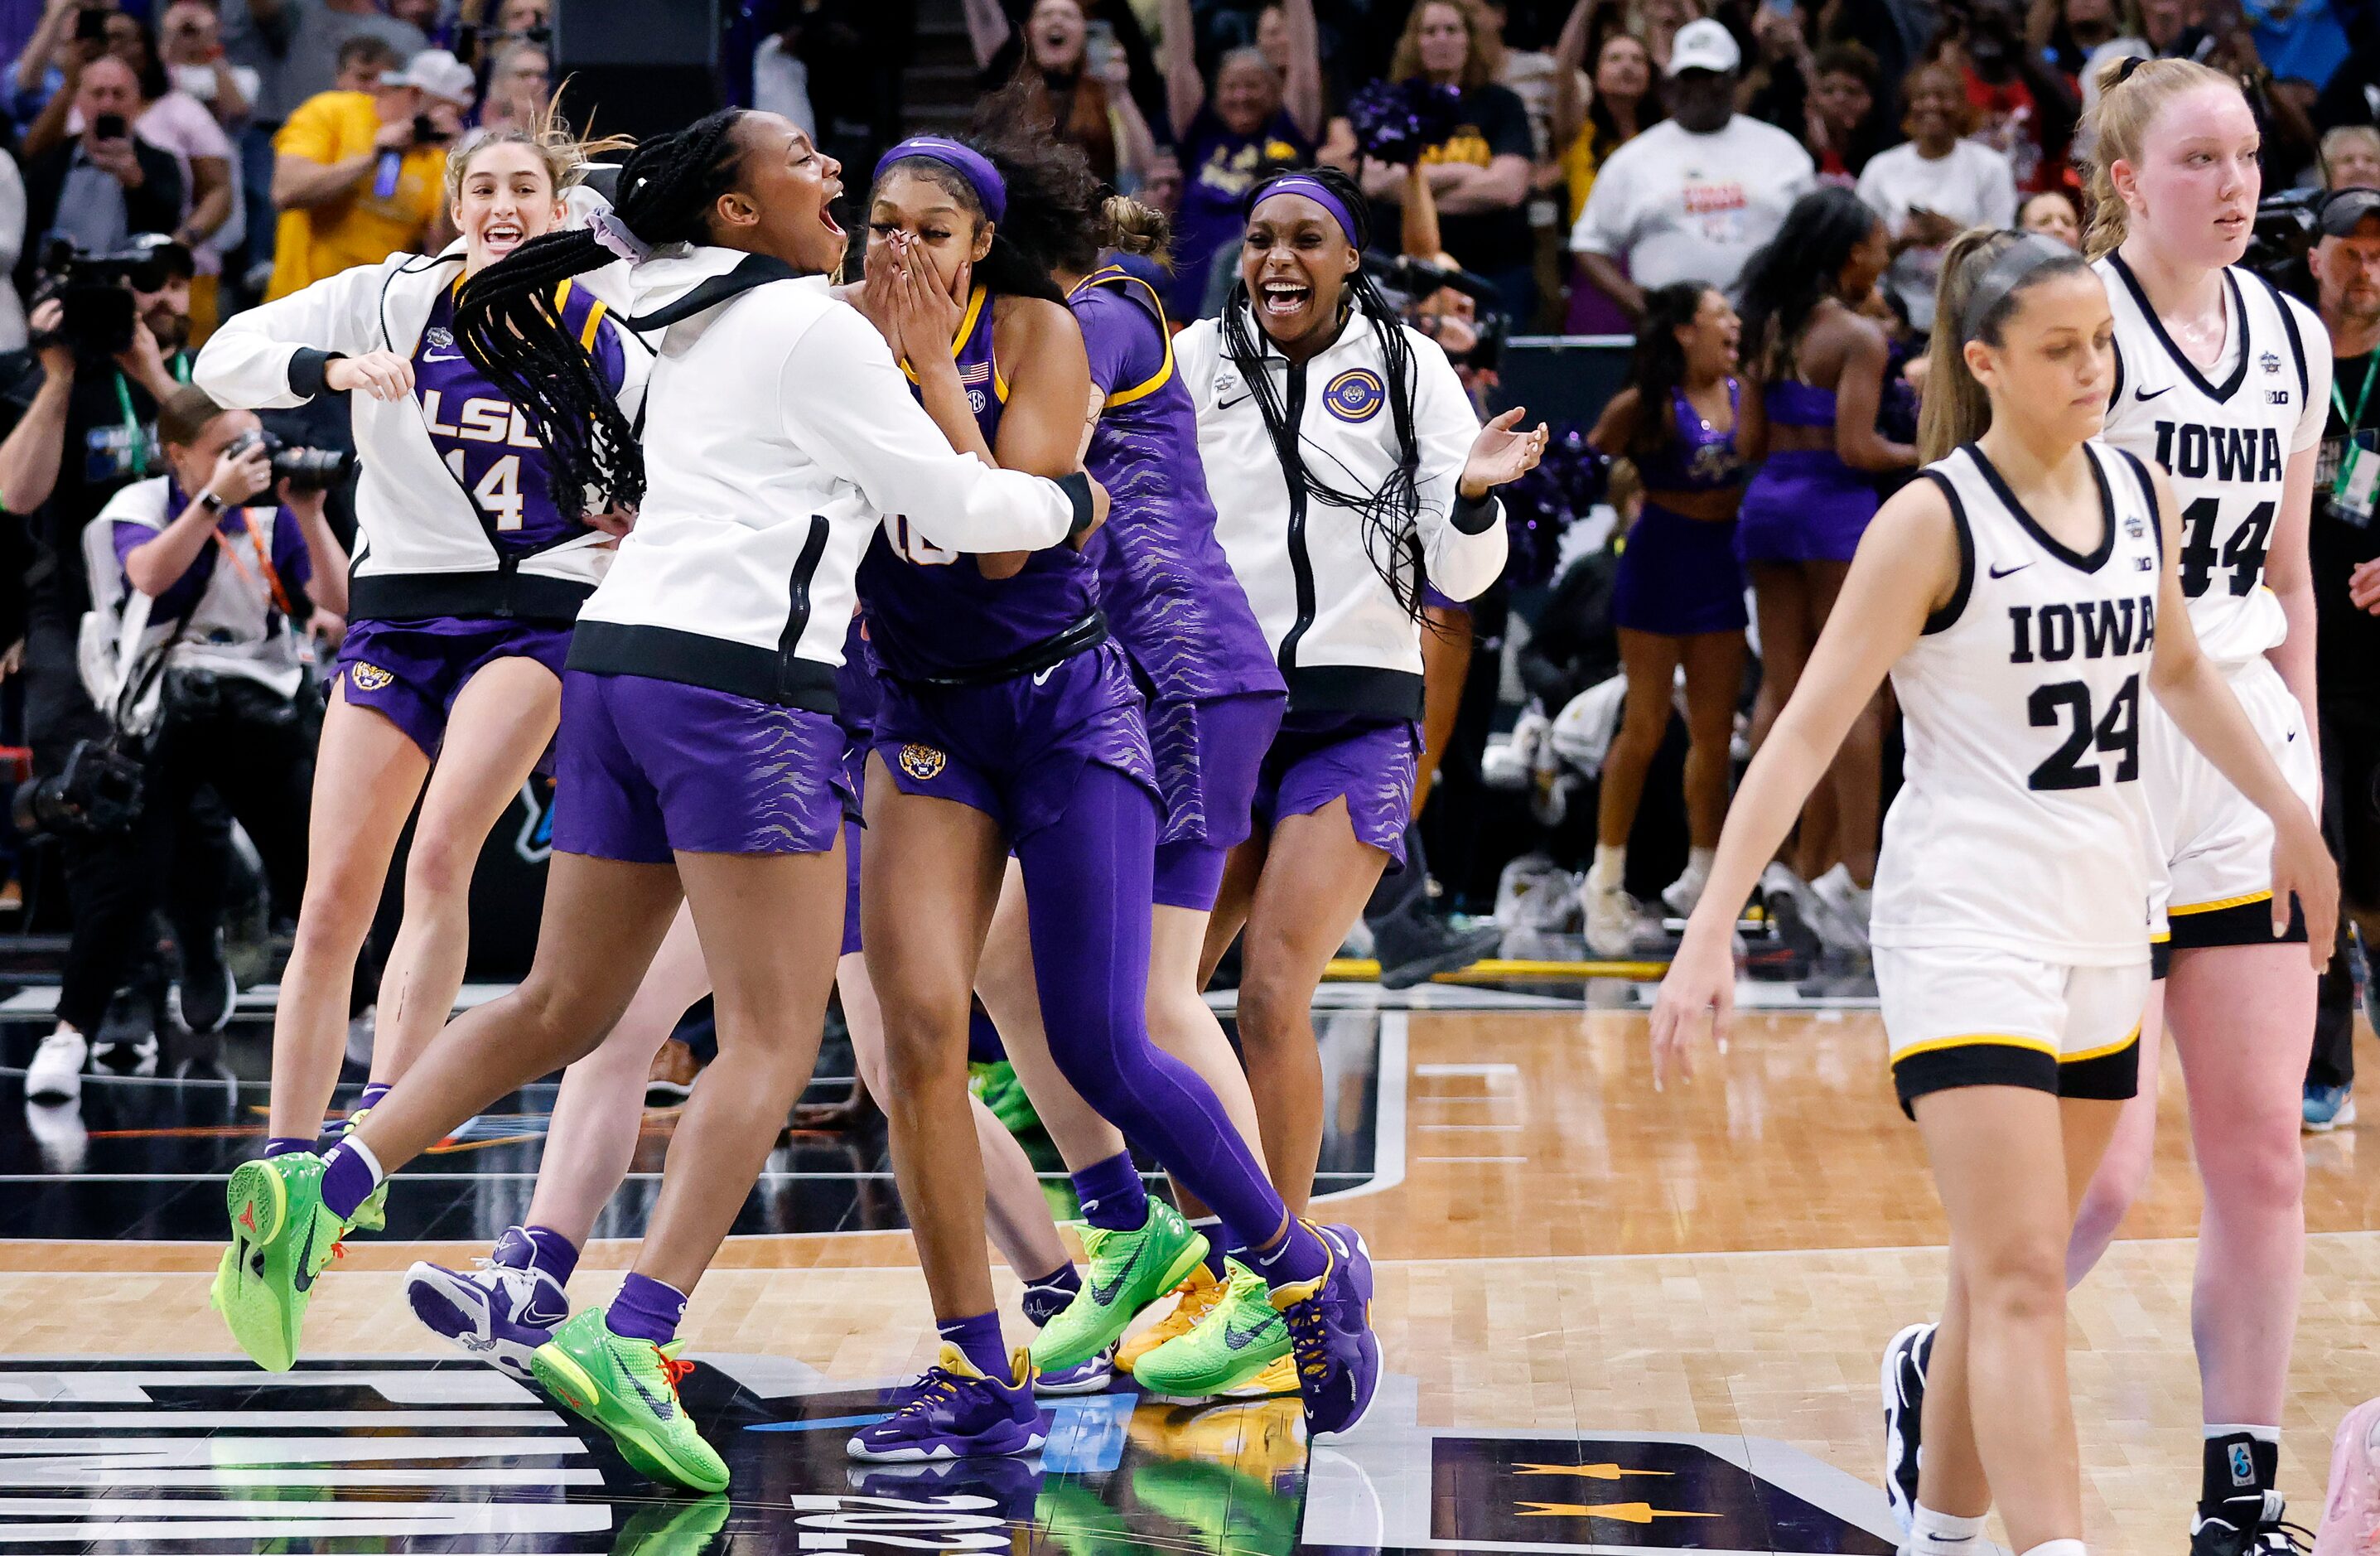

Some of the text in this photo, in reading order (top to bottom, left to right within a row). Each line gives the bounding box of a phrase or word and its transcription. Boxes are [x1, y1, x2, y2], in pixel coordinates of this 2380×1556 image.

[2155, 420, 2282, 482] IOWA
[2180, 498, 2276, 597] 44
[2009, 596, 2154, 663] IOWA
[2028, 671, 2140, 790] 24
[790, 1495, 1011, 1556] 202
